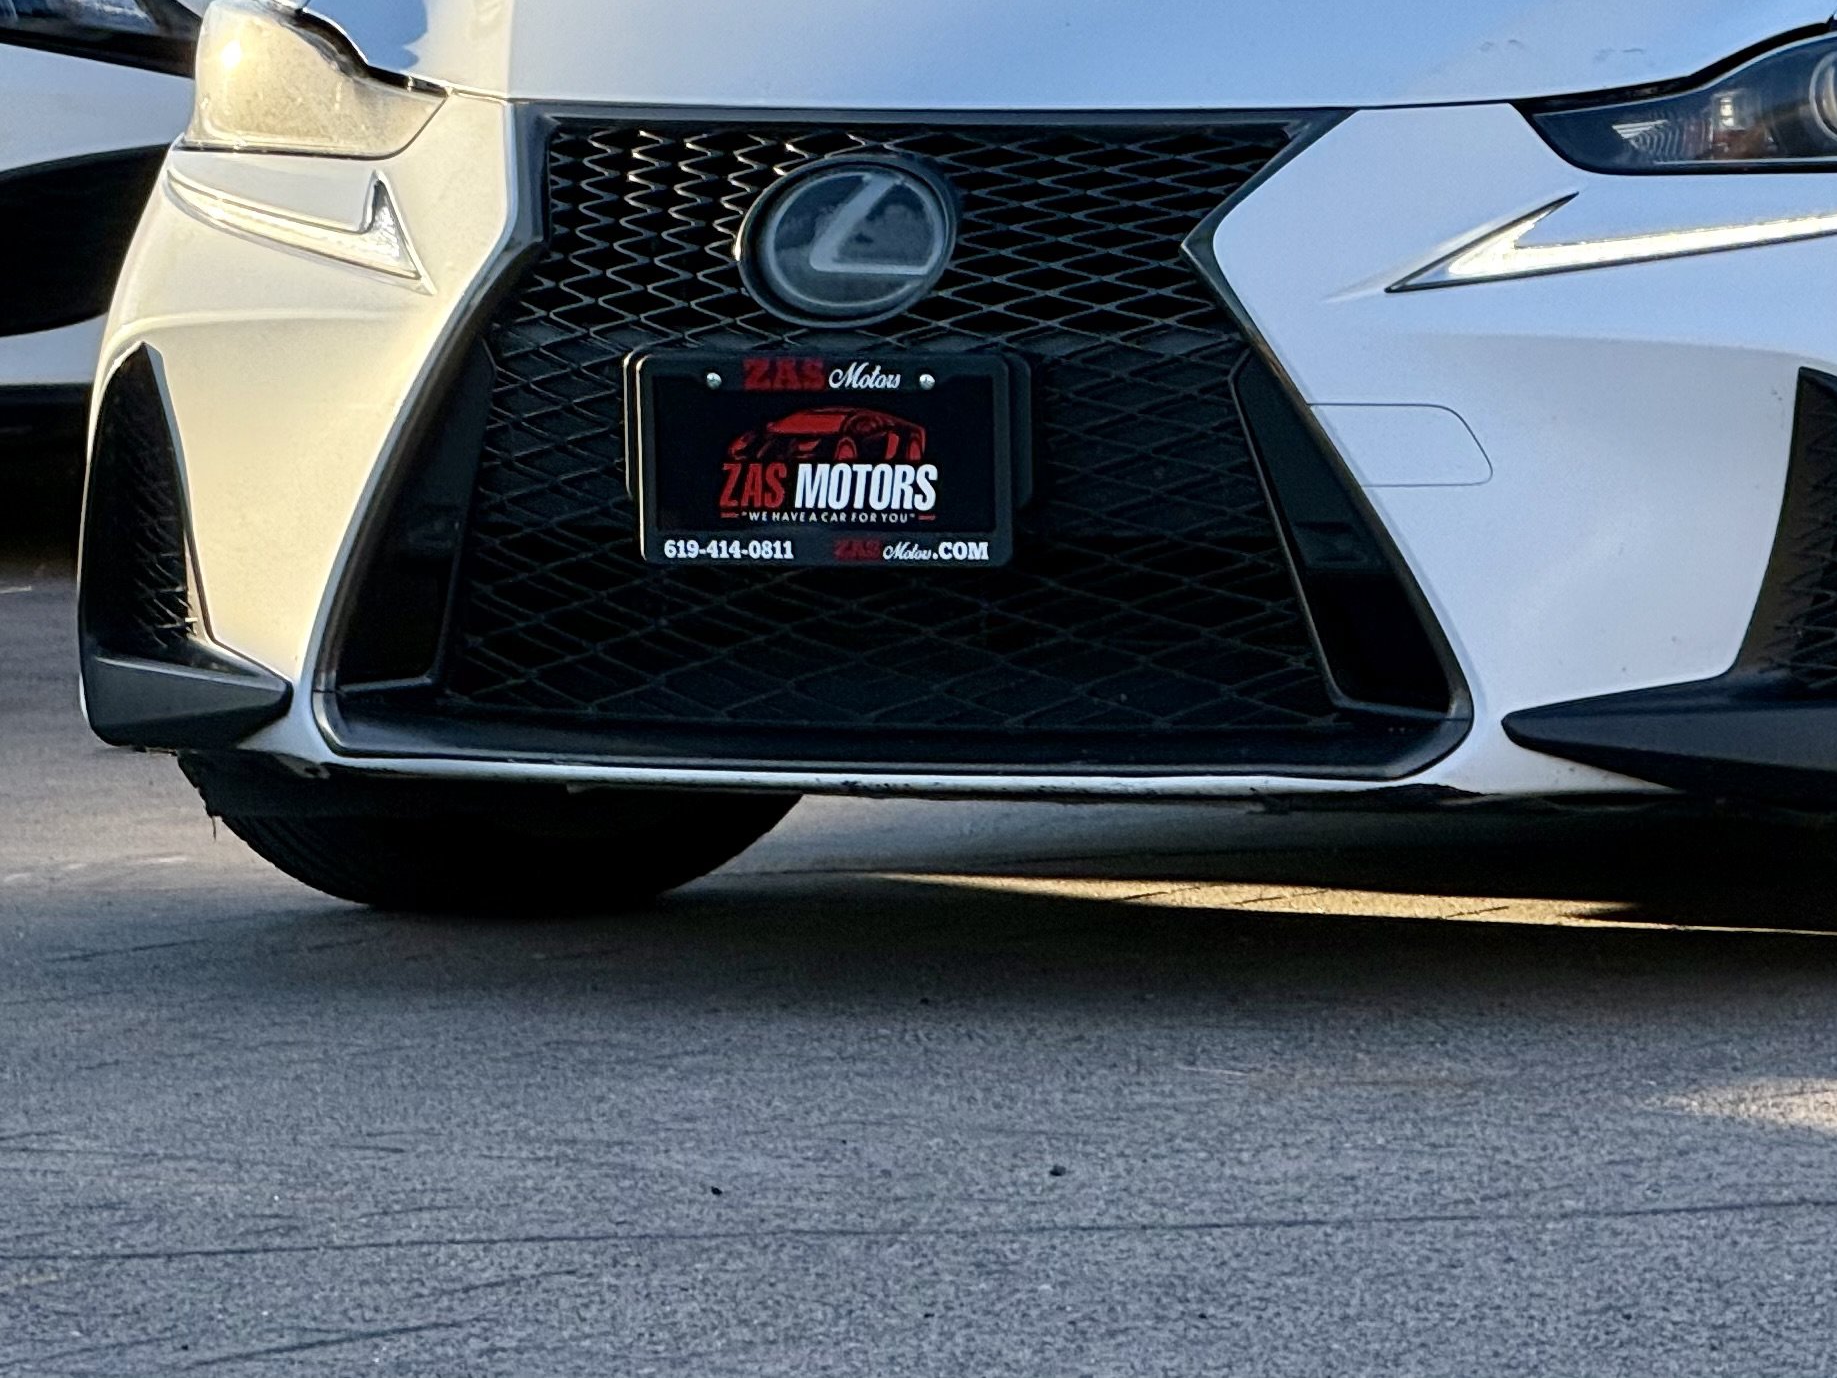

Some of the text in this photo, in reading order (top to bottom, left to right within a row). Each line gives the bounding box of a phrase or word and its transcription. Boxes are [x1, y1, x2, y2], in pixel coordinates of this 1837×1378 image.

[744, 357, 901, 390] ZAS Motors
[719, 462, 938, 511] ZAS MOTORS
[772, 511, 805, 521] HAVE
[808, 511, 818, 522] A
[821, 511, 847, 522] CAR
[851, 511, 877, 522] FOR
[663, 539, 794, 560] 619-414-0811
